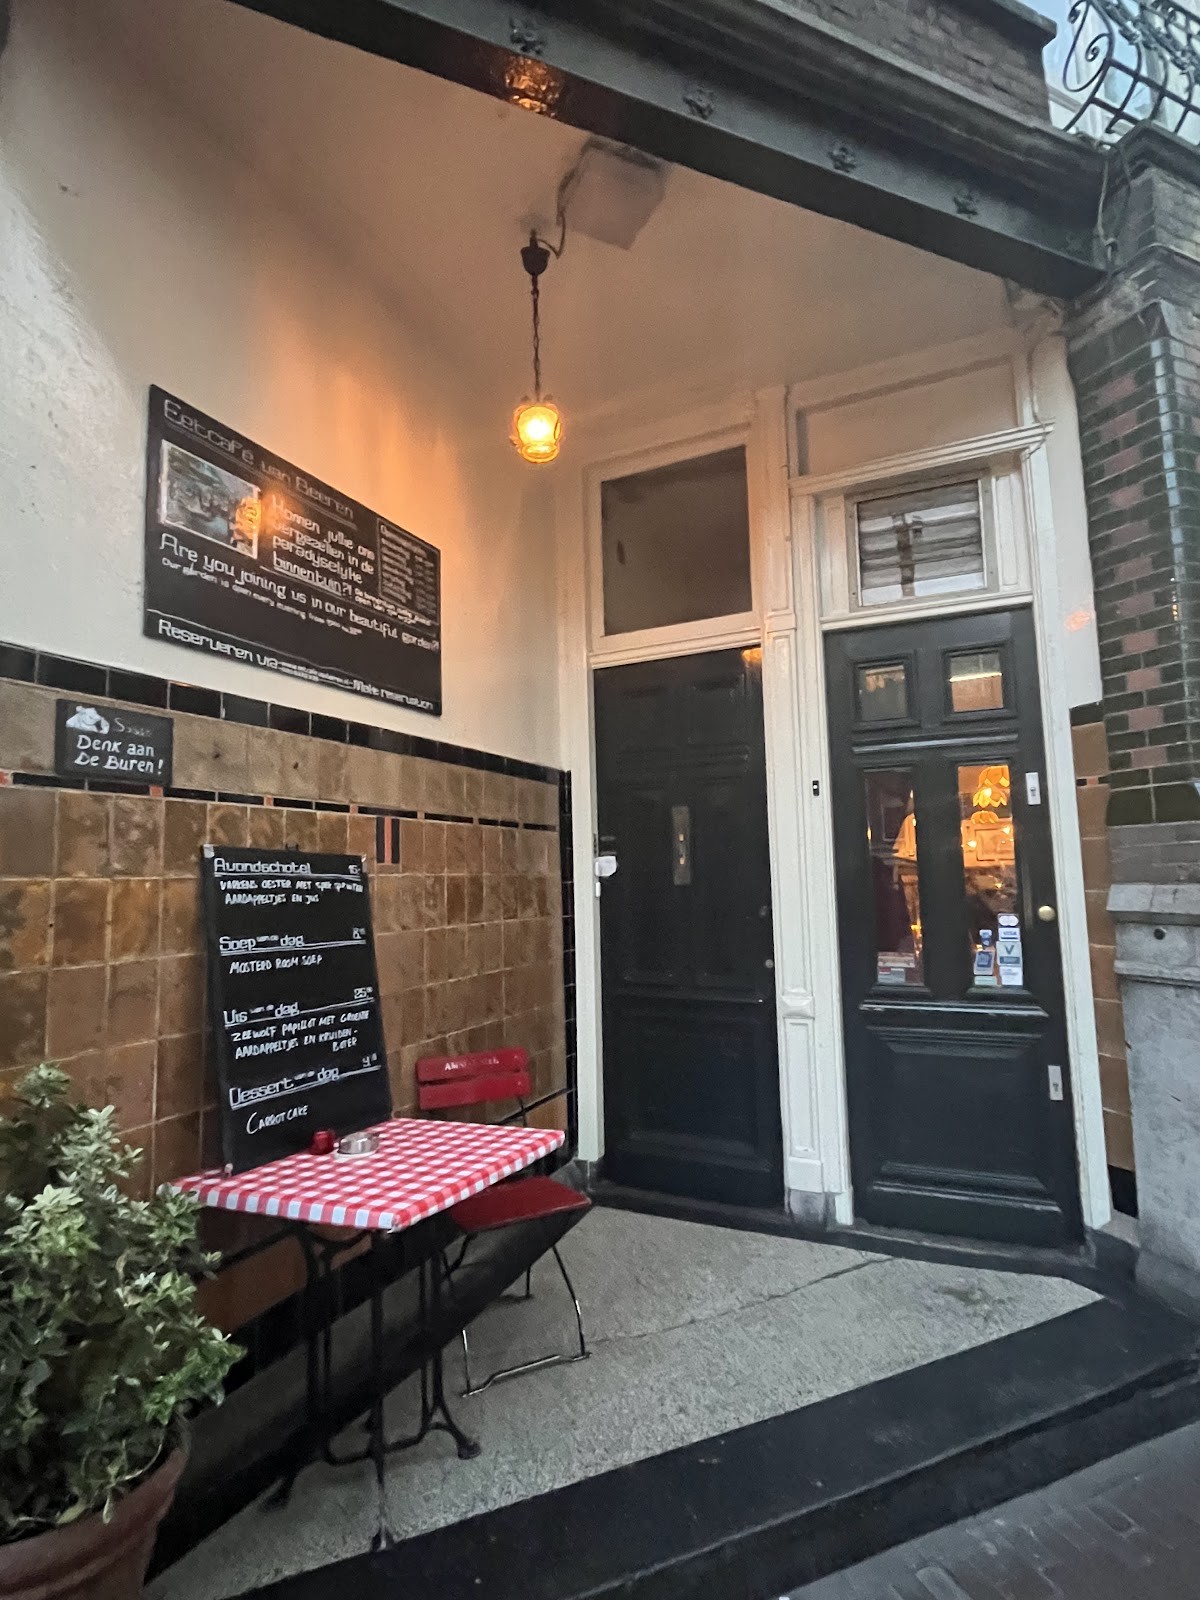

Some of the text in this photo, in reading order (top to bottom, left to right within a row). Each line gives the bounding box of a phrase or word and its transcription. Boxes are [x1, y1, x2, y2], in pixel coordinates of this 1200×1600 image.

[260, 459, 292, 487] van
[295, 475, 354, 520] Beeren
[271, 494, 321, 534] Komen
[358, 546, 376, 562] ons
[161, 557, 181, 569] Our
[347, 551, 359, 568] in
[361, 561, 375, 575] de
[160, 532, 198, 564] Are
[202, 553, 235, 578] you
[234, 567, 286, 600] joining
[292, 590, 307, 605] us
[312, 595, 323, 611] in
[325, 600, 346, 618] our
[350, 609, 399, 640] beautiful
[159, 619, 279, 670] Reserveren via
[352, 680, 434, 710] Make reservation
[76, 734, 155, 757] Denk aan
[74, 751, 99, 767] De
[213, 858, 312, 875] Avondschotel
[295, 880, 312, 890] MET
[291, 893, 303, 903] EN
[219, 935, 257, 953] Soep
[279, 933, 305, 948] dag
[230, 954, 323, 974] MOSTERD ROOM SOEP
[223, 1008, 248, 1024] Vis
[274, 1002, 300, 1017] dag
[318, 1014, 335, 1026] MET
[303, 1035, 316, 1046] EN
[332, 1036, 358, 1052] BOTER
[229, 1077, 294, 1105] Dessert
[317, 1066, 340, 1081] dag
[287, 1105, 309, 1121] CAKE
